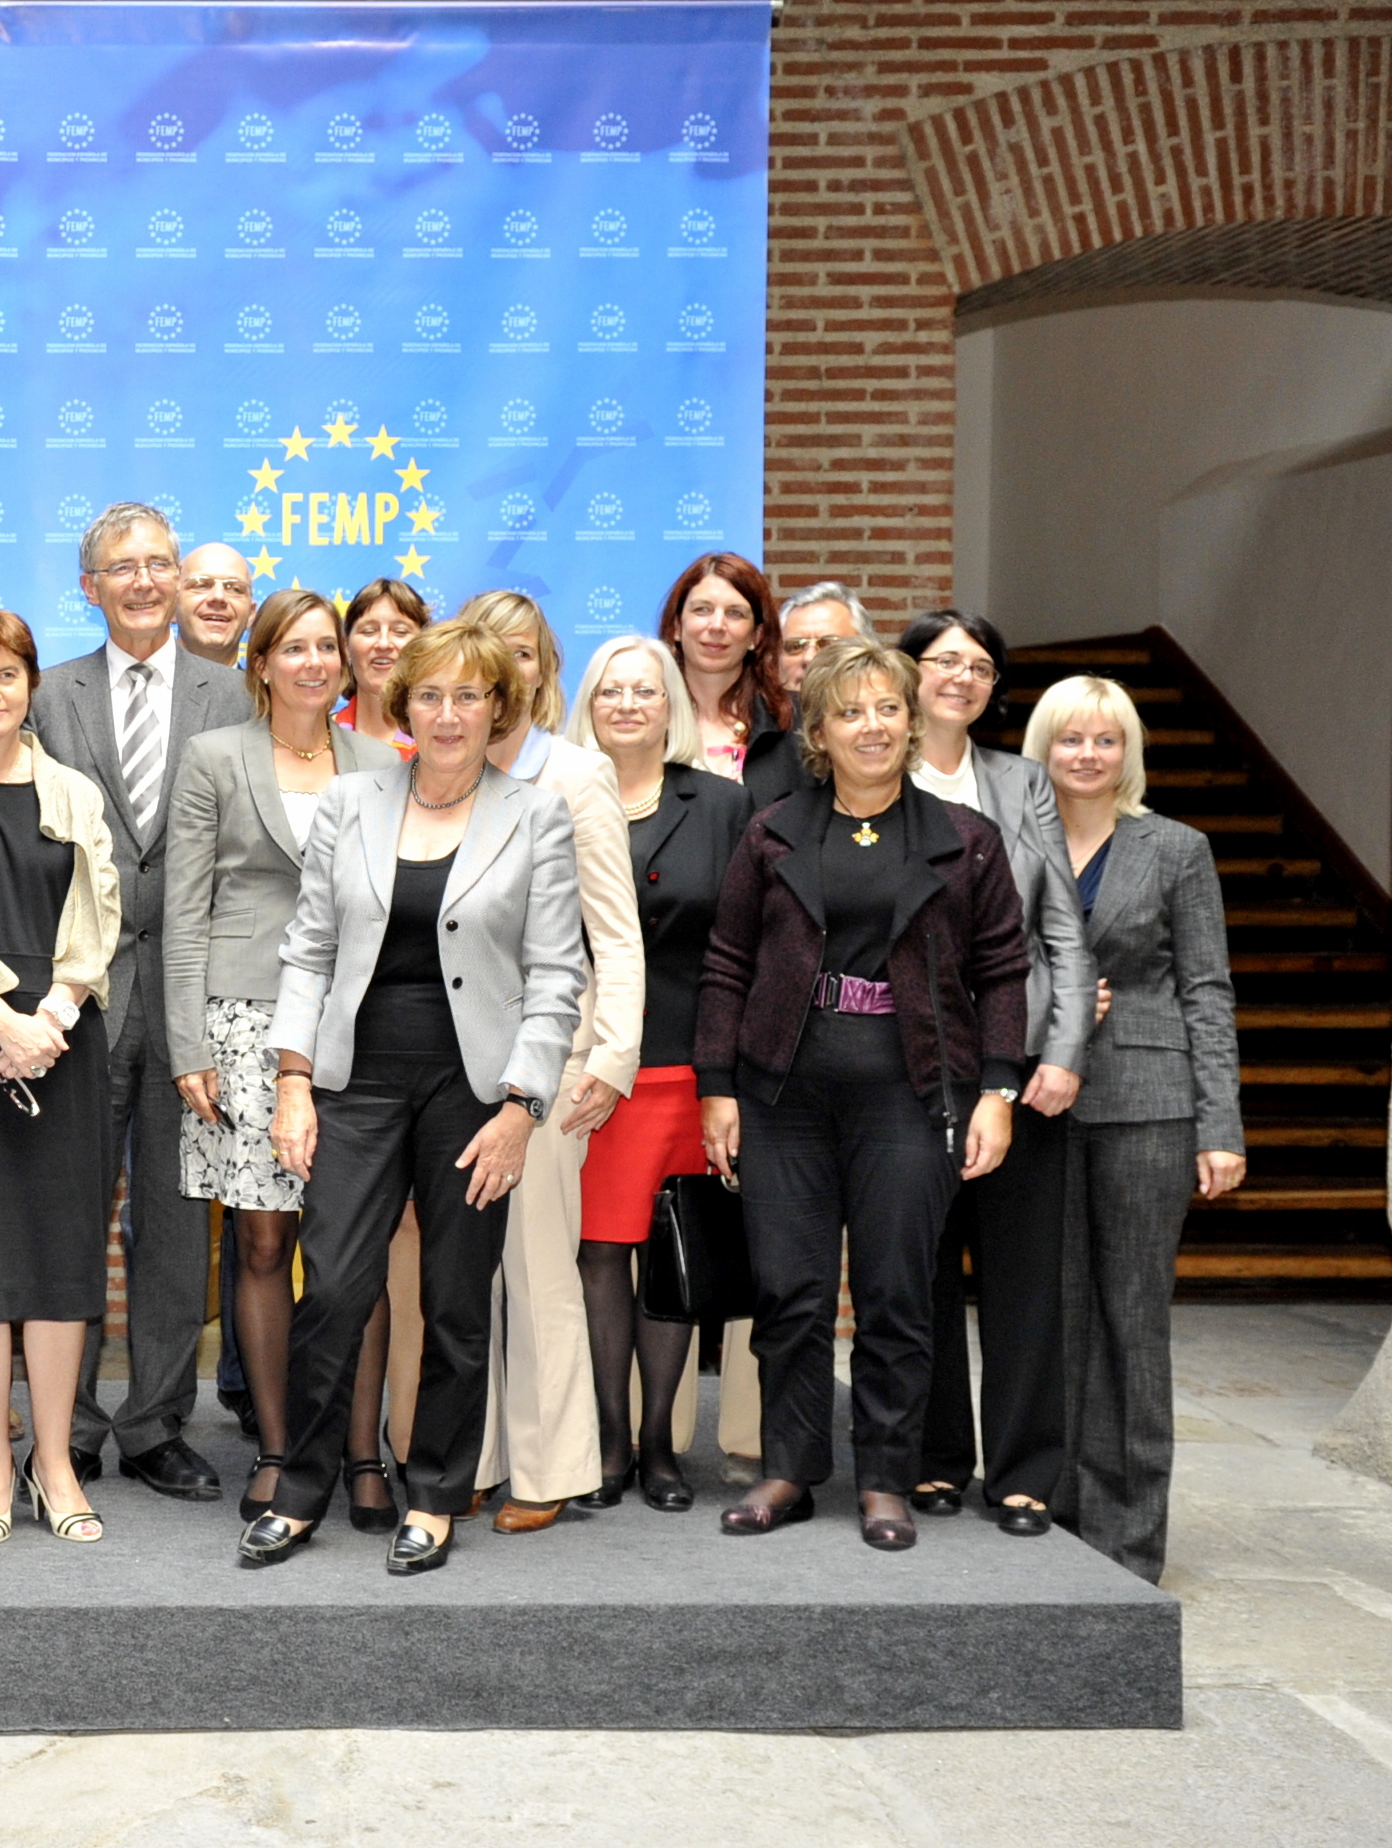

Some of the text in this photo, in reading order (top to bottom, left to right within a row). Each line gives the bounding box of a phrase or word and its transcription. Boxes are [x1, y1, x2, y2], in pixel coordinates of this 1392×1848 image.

[66, 125, 88, 136] FEMP
[156, 125, 178, 136] FEMP
[245, 125, 267, 137] FEMP
[334, 125, 356, 137] FEMP
[423, 126, 445, 137] FEMP
[512, 125, 534, 137] FEMP
[600, 125, 622, 136] FEMP
[689, 125, 711, 136] FEMP
[66, 221, 88, 232] FEMP
[156, 221, 177, 232] FEMP
[244, 221, 266, 232] FEMP
[334, 221, 355, 232] FEMP
[422, 221, 444, 232] FEMP
[510, 221, 532, 232] FEMP
[599, 220, 620, 232] FEMP
[688, 220, 709, 232] FEMP
[66, 316, 88, 328] FEMP
[155, 316, 177, 327] FEMP
[244, 316, 265, 328] FEMP
[333, 316, 355, 327] FEMP
[422, 316, 443, 327] FEMP
[509, 316, 530, 327] FEMP
[598, 315, 619, 326] FEMP
[686, 315, 707, 326] FEMP
[65, 411, 87, 422] FEMP
[154, 411, 176, 422] FEMP
[243, 411, 265, 422] FEMP
[420, 411, 441, 422] FEMP
[508, 410, 530, 422] FEMP
[596, 410, 618, 421] FEMP
[684, 410, 706, 421] FEMP
[65, 506, 86, 518] FEMP
[507, 504, 529, 515] FEMP
[595, 504, 616, 515] FEMP
[683, 504, 704, 515] FEMP
[281, 492, 399, 545] FEMP
[64, 602, 86, 613] FEMP
[594, 598, 616, 609] FEMP
